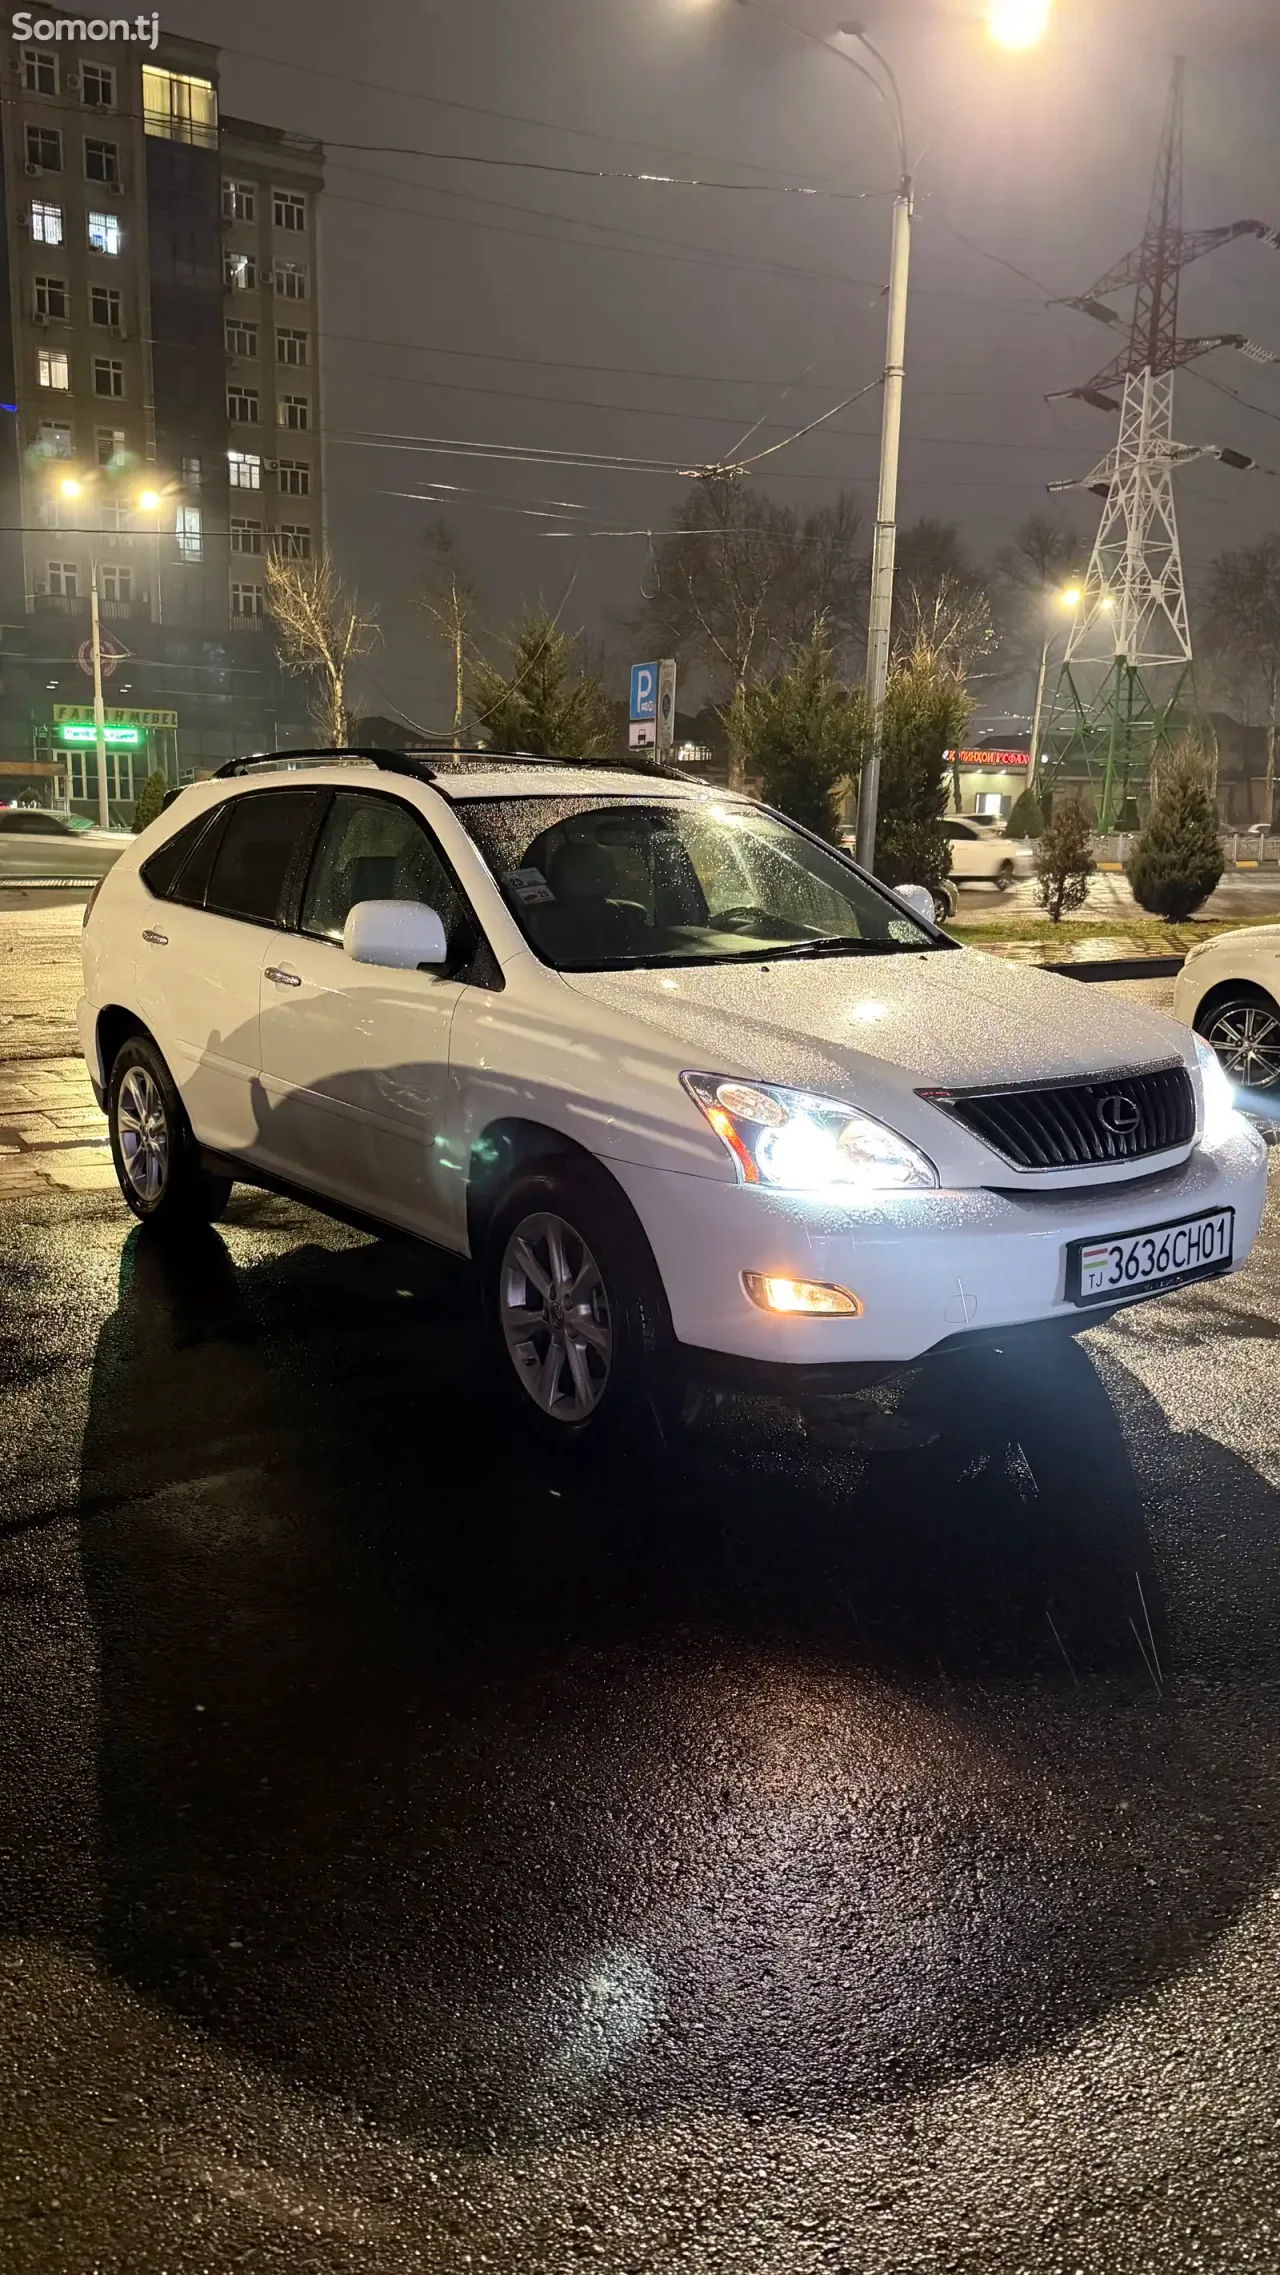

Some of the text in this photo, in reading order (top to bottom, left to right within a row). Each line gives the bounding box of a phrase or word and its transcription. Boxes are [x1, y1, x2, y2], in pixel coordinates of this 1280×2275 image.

[638, 670, 652, 713] P
[1108, 1218, 1225, 1284] 3636CH01
[1089, 1272, 1103, 1289] TJ
